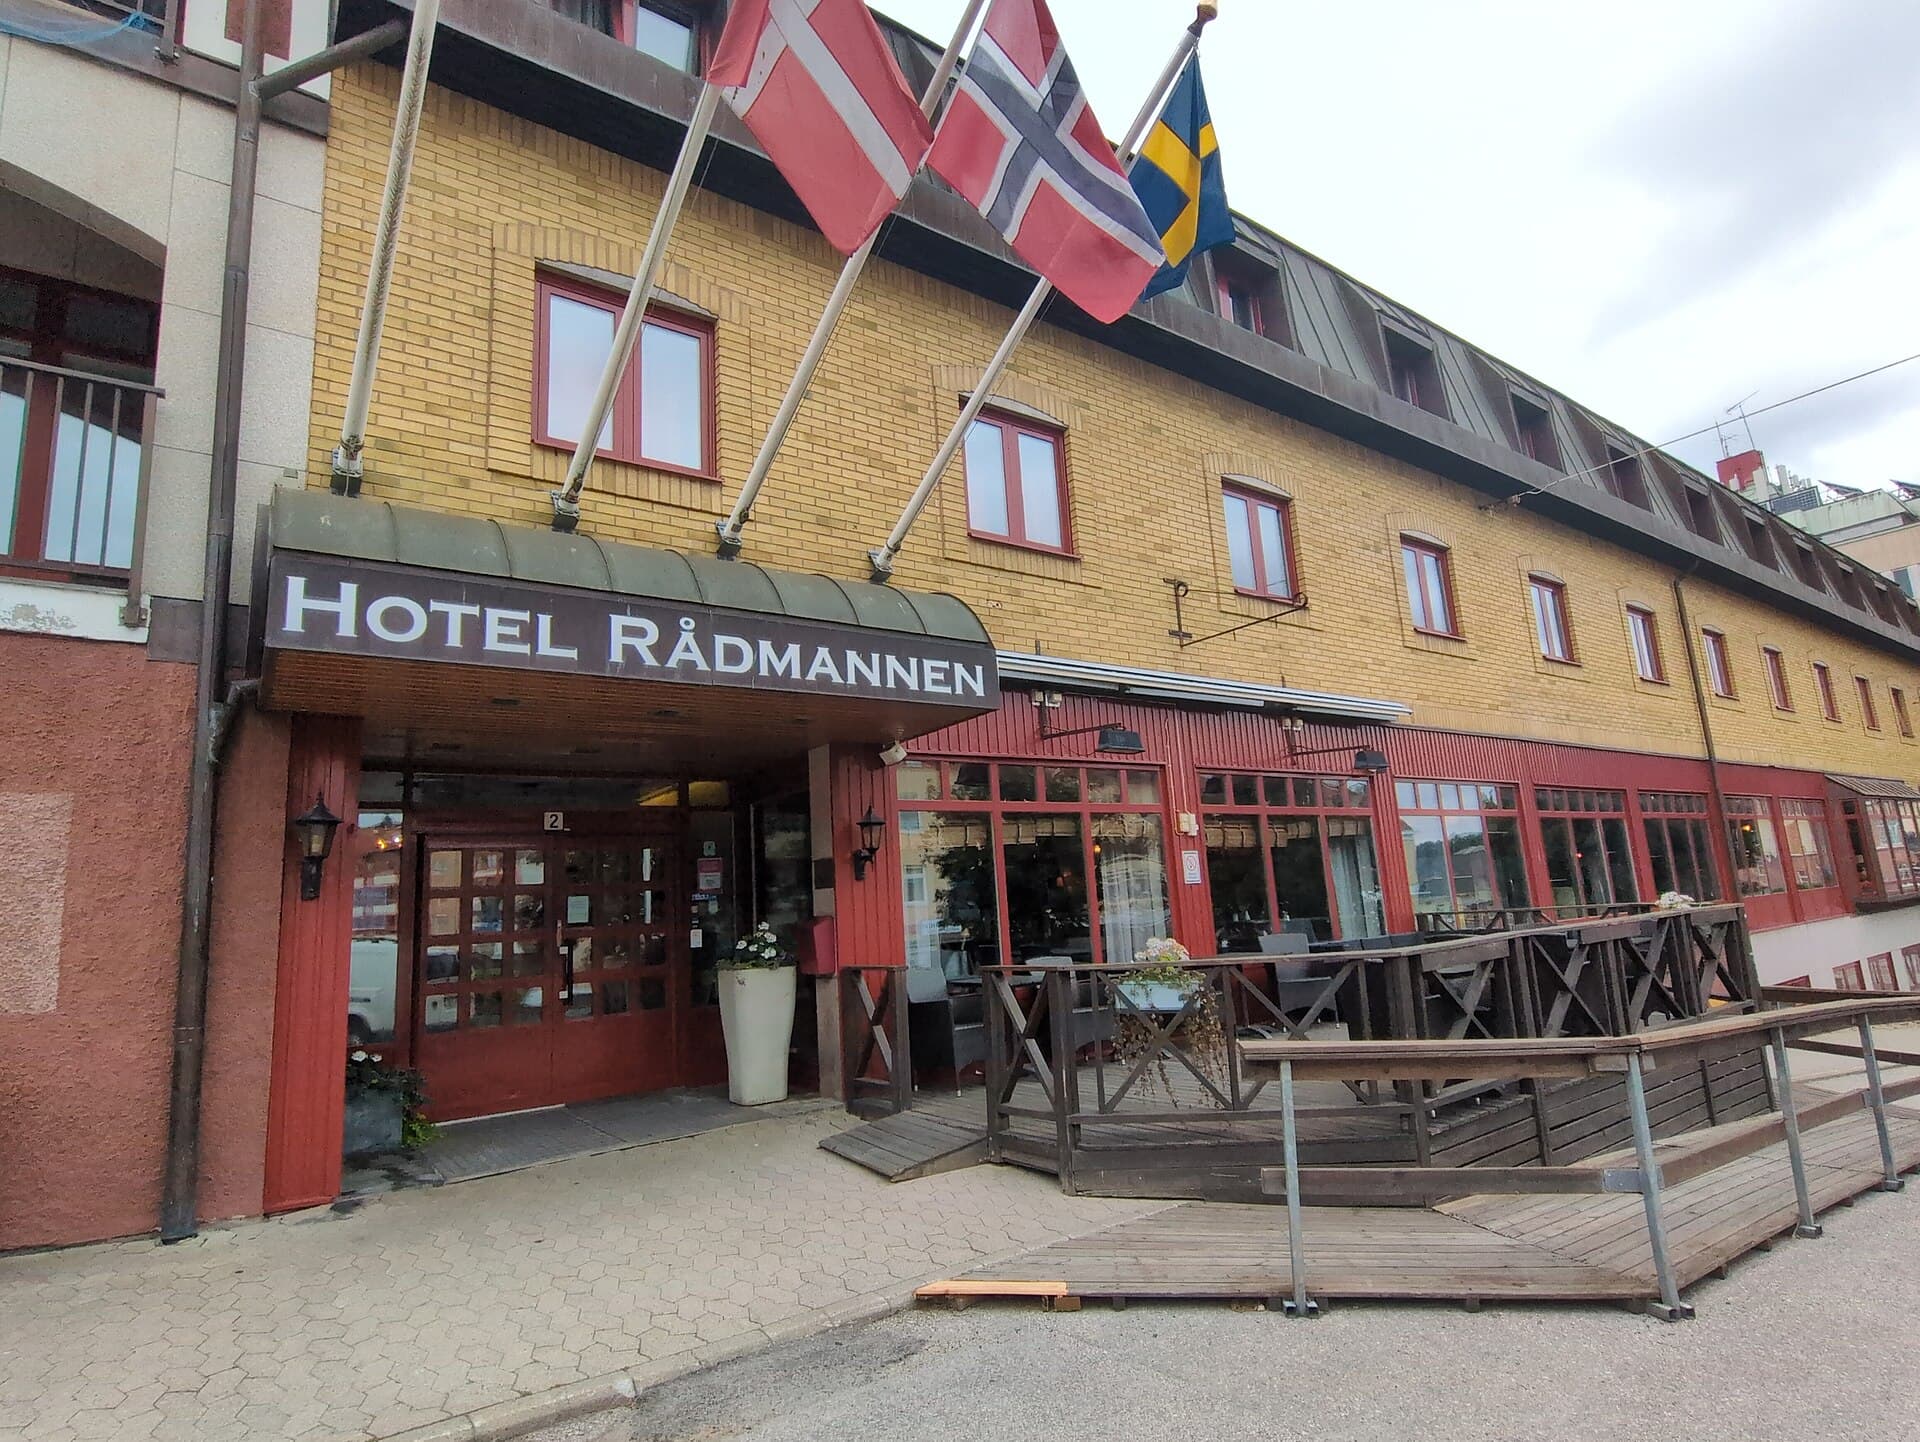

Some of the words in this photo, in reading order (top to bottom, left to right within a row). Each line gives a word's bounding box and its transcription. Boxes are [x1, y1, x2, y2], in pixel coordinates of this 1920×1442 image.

[282, 575, 578, 660] HOTEL
[608, 613, 985, 697] RÅDMANNEN
[550, 814, 559, 829] 2
